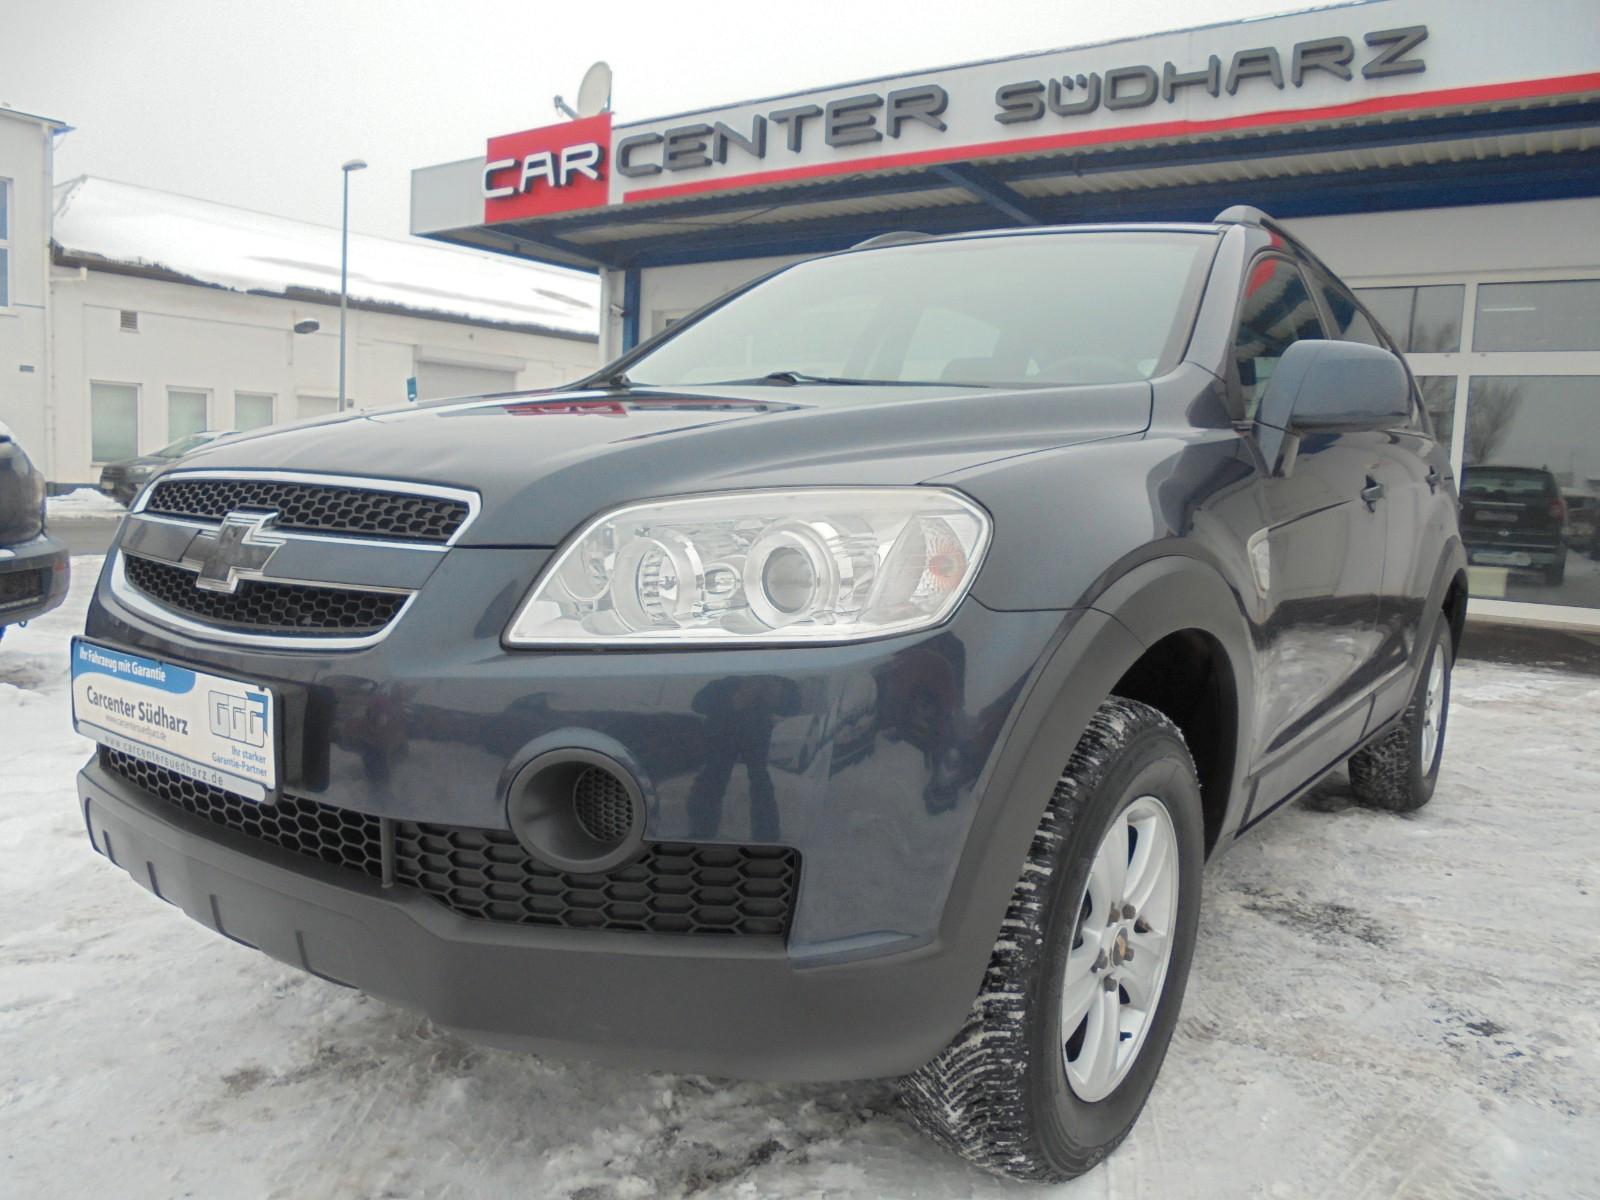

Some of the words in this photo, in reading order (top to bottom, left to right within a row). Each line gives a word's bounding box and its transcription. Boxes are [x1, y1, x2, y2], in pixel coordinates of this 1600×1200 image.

[481, 142, 606, 199] CAR
[616, 83, 949, 178] CENTER
[995, 24, 1428, 126] SÜDHARZ
[88, 649, 117, 673] Fahrzeug
[118, 659, 131, 674] mit
[131, 661, 166, 682] Garantie
[86, 685, 136, 718] Carcenter
[138, 701, 188, 736] Südharz
